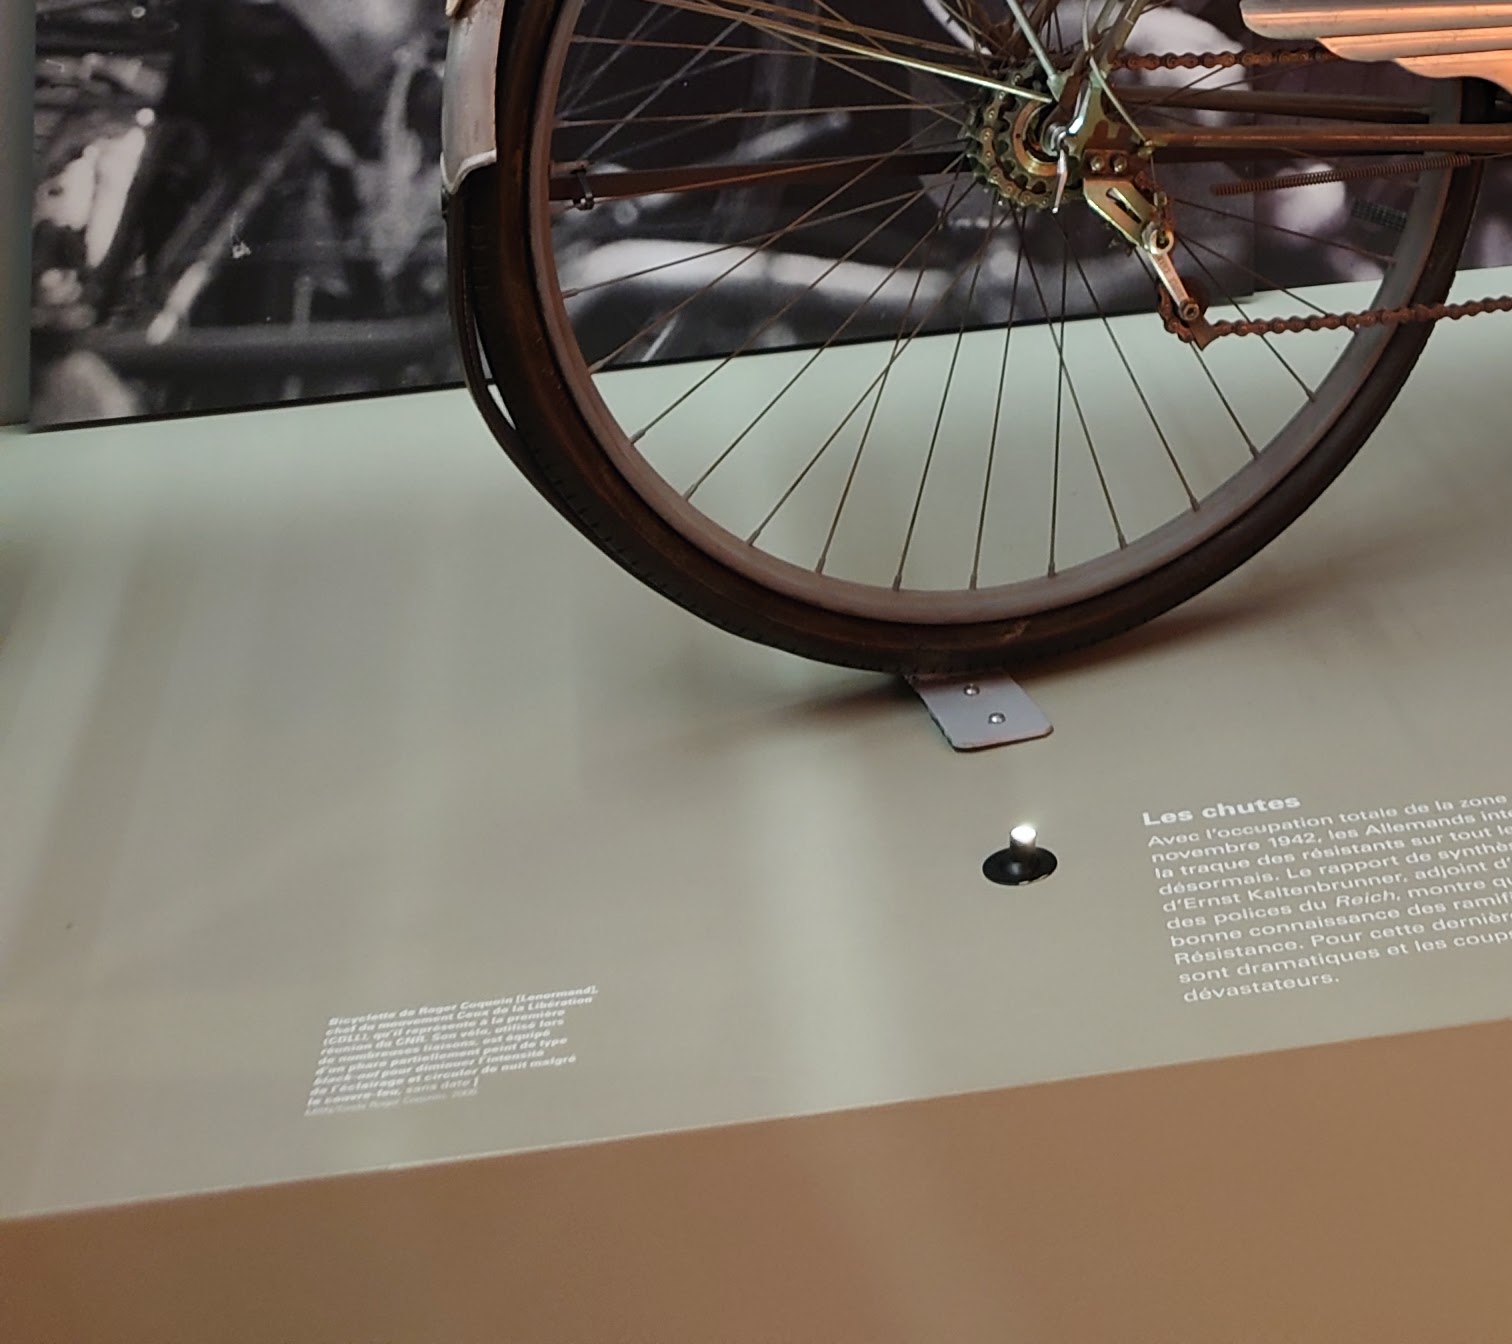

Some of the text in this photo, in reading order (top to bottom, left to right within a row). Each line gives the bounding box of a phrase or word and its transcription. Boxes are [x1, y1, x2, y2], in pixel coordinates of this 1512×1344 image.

[1142, 797, 1300, 826] Les chutes
[1147, 832, 1200, 848] Avec
[1338, 807, 1398, 823] totale
[1404, 803, 1429, 815] de
[1434, 800, 1454, 811] la
[1459, 795, 1507, 808] zone
[1151, 841, 1260, 863] novembre
[1267, 832, 1322, 848] 1942,
[1327, 829, 1359, 840] les
[1365, 813, 1476, 836] Allemands
[1154, 867, 1174, 879] la
[1179, 859, 1250, 876] traque
[1257, 853, 1295, 866] des
[1302, 839, 1405, 860] résistants
[1410, 834, 1443, 846] sur
[1448, 827, 1492, 842] tout
[1158, 871, 1279, 895] désormais.
[1286, 867, 1312, 879] Le
[1318, 855, 1399, 875] rapport
[1405, 851, 1431, 864] de
[1247, 873, 1408, 901] Kaltenbrunner,
[1414, 861, 1488, 880] adjoint
[1166, 916, 1206, 929] des
[1213, 905, 1292, 926] polices
[1298, 899, 1327, 912] du
[1335, 889, 1401, 908] Reich,
[1407, 880, 1486, 899] montre
[1170, 929, 1242, 947] bonne
[1248, 909, 1400, 937] connaissance
[1407, 903, 1446, 916] des
[1174, 941, 1304, 965] Résistance.
[1310, 931, 1362, 947] Pour
[1369, 924, 1425, 939] cette
[1179, 966, 1230, 983] sont
[1236, 948, 1380, 976] dramatiques
[1386, 943, 1409, 955] et
[1414, 939, 1447, 952] les
[1183, 974, 1339, 1002] dévastateurs.
